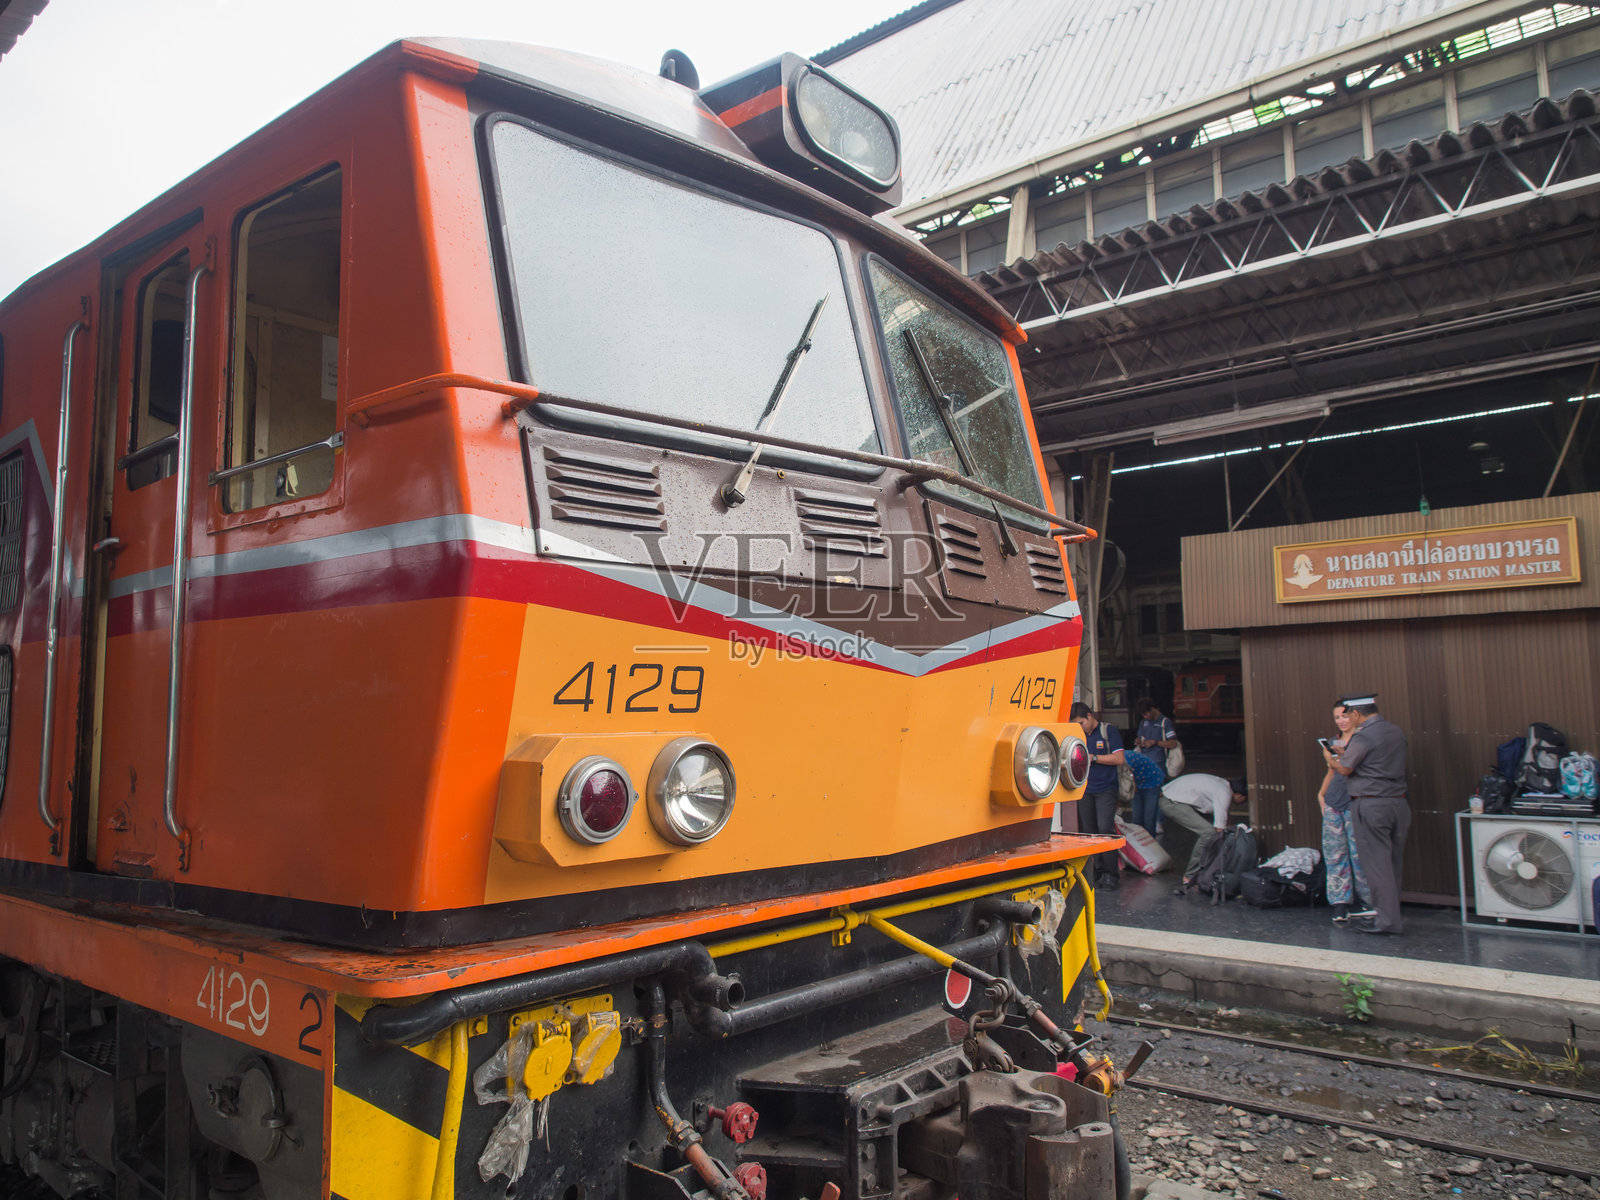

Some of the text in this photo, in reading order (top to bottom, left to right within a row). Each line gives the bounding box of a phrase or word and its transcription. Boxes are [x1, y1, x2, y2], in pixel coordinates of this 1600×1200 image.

[1325, 537, 1560, 573] นายสถานีปล่อยขบวนรถ
[1327, 560, 1562, 590] DEPARTURE TRAIN STATION MASTER
[553, 661, 705, 714] 4129
[1010, 675, 1057, 710] 4129
[197, 965, 270, 1037] 4129
[298, 992, 323, 1057] 2
